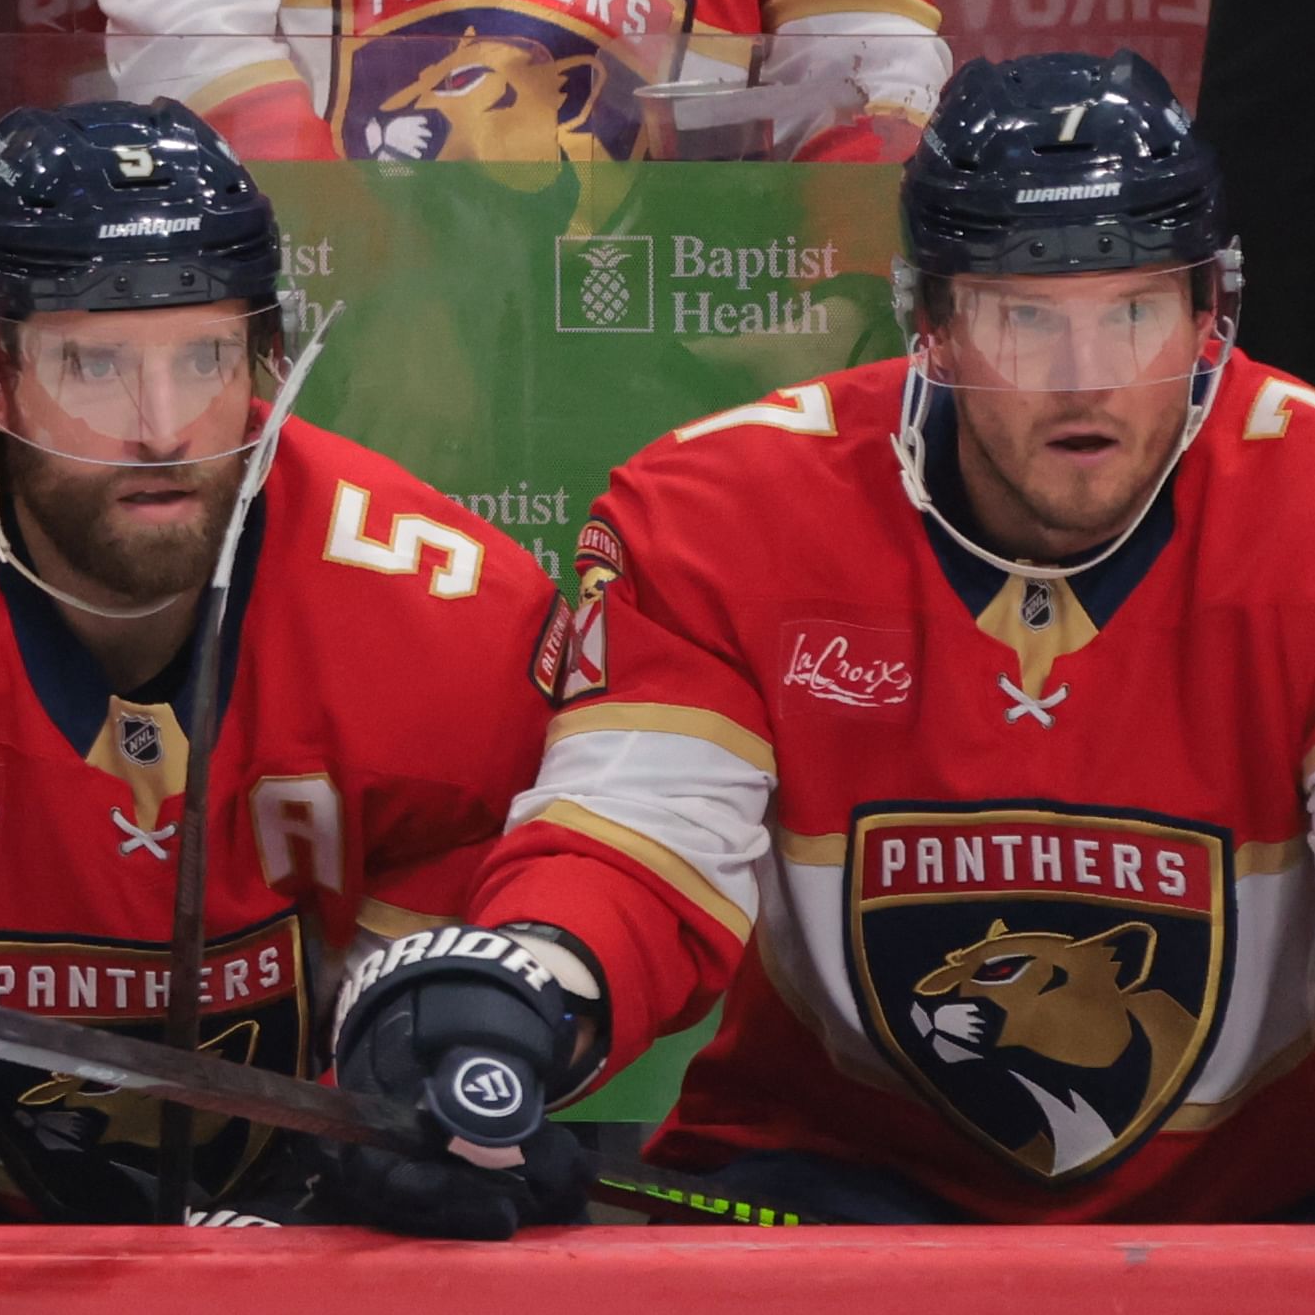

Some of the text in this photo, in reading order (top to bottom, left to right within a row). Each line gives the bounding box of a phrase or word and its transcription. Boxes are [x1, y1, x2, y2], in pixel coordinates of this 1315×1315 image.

[1050, 104, 1089, 142] 7
[112, 145, 154, 178] 5
[1015, 182, 1123, 205] WARRIOR
[97, 215, 204, 240] WARRIOR
[671, 235, 840, 290] Baptist
[673, 291, 830, 335] Health
[674, 381, 839, 444] 7
[322, 479, 485, 600] 5
[783, 632, 912, 707] LaCroix
[129, 730, 154, 753] NHL
[249, 772, 343, 893] A
[881, 834, 1186, 897] PANTHERS
